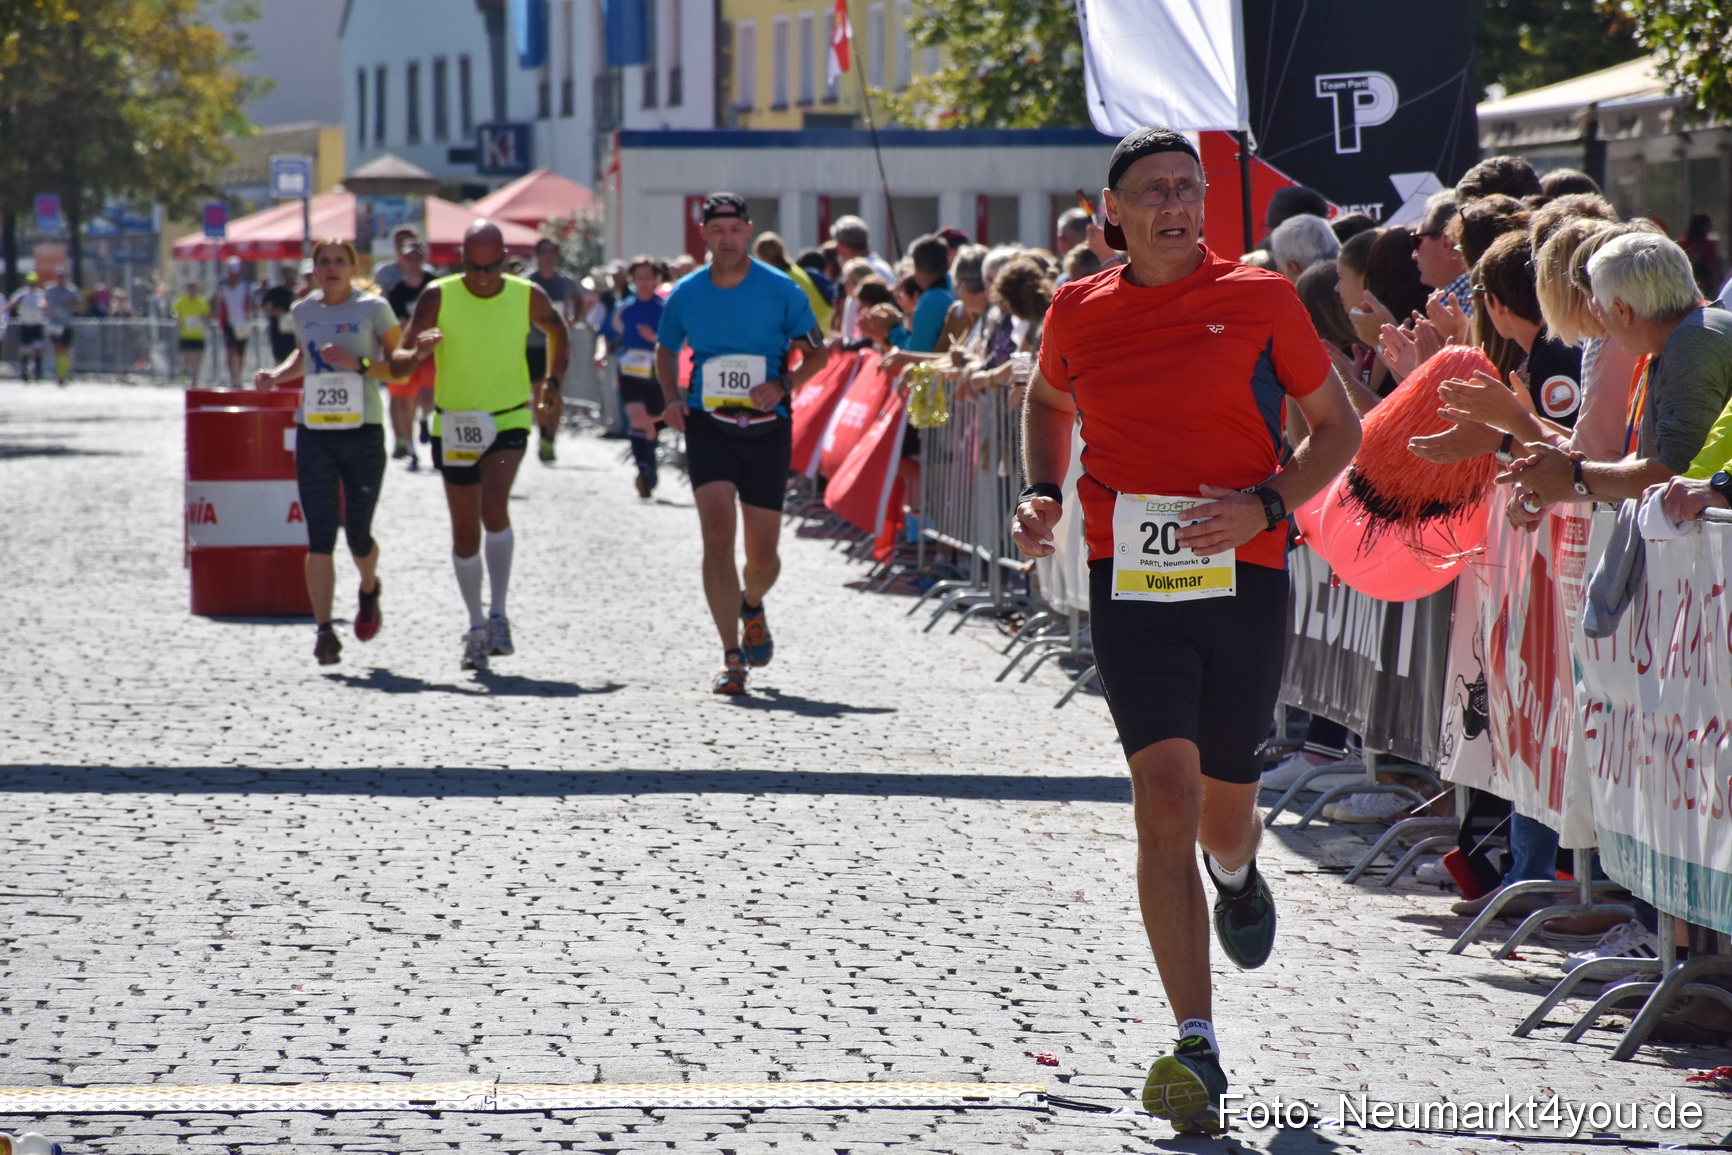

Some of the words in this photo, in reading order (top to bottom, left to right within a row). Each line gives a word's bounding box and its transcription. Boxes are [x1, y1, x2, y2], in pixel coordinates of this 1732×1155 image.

[1322, 81, 1346, 90] Team
[718, 371, 750, 390] 180
[317, 388, 348, 406] 239
[455, 426, 483, 444] 188
[1146, 500, 1197, 513] BOCK
[1140, 559, 1162, 568] PARTL
[1163, 558, 1199, 567] Neumarkt
[1145, 574, 1204, 590] Volkmar
[1183, 1020, 1209, 1031] SOCKS
